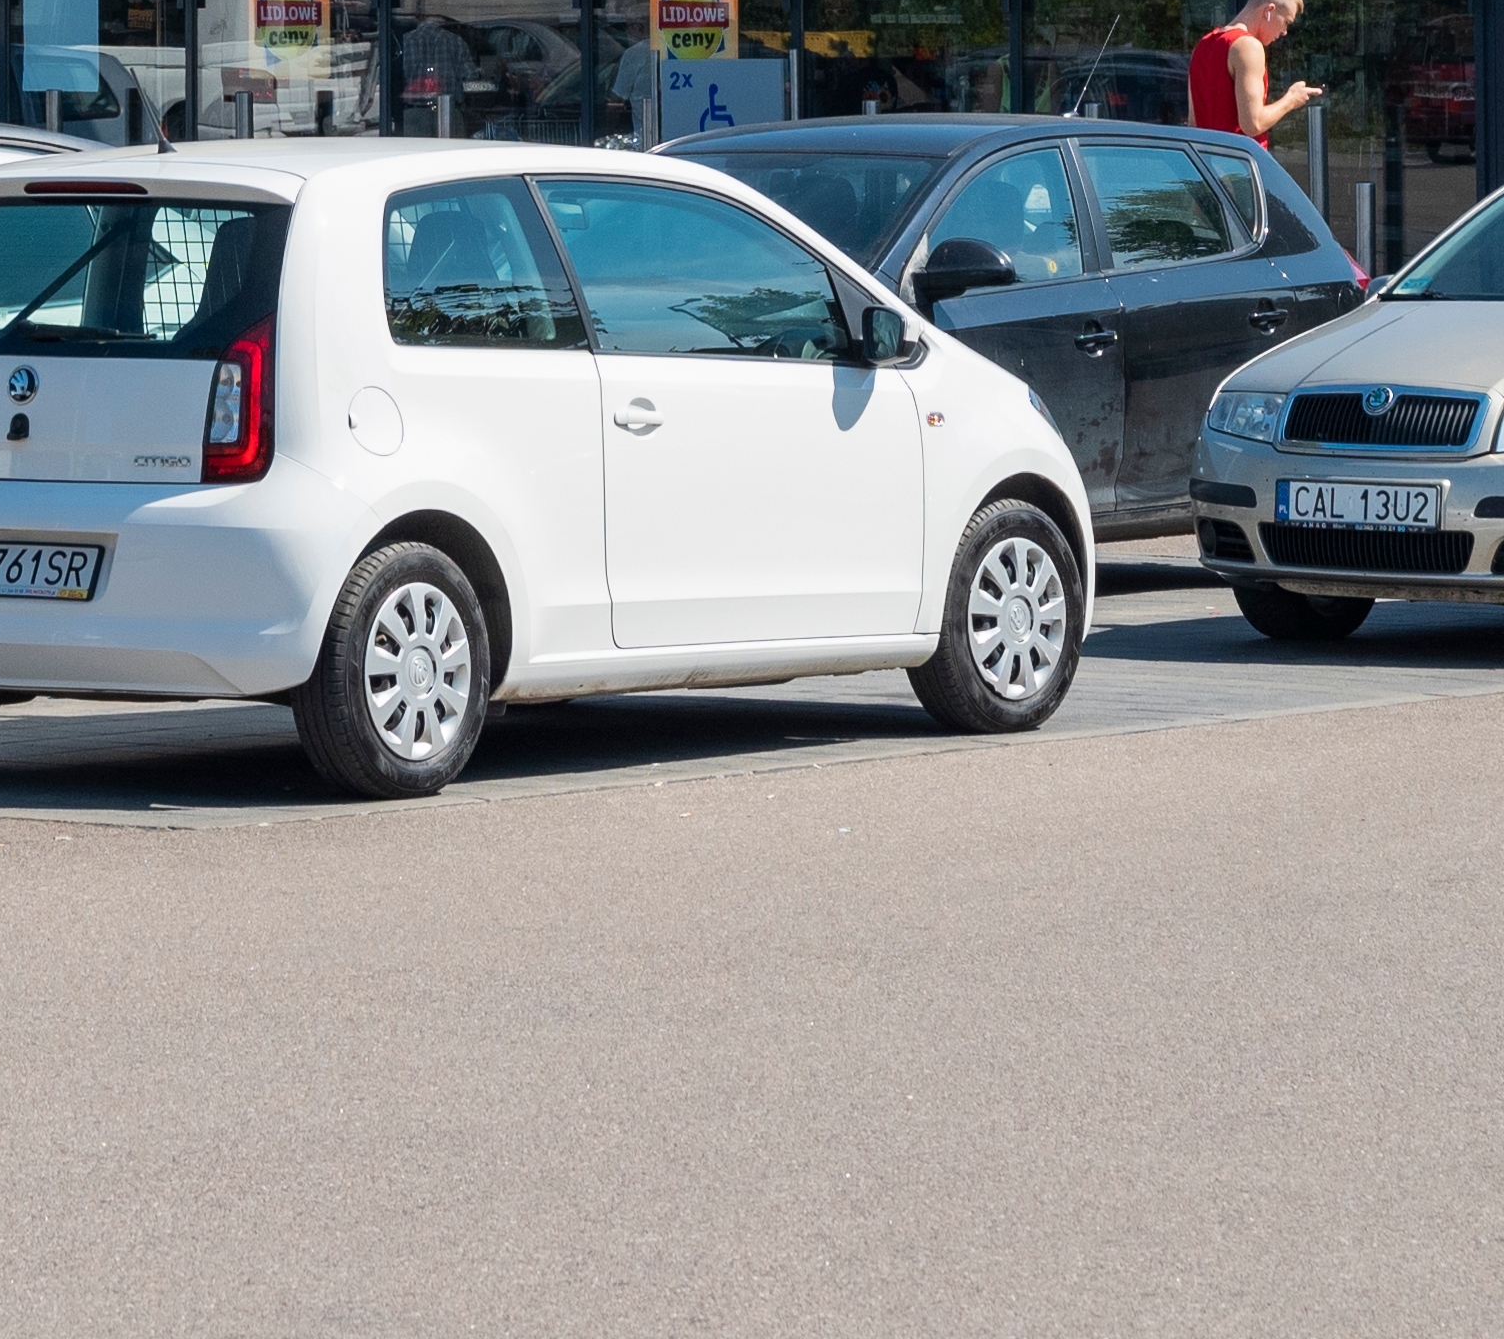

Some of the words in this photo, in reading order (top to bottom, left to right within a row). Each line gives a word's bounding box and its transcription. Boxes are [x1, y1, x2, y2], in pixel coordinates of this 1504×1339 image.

[260, 5, 319, 21] LIDLOWE
[662, 5, 725, 23] LIDLOWE
[269, 30, 309, 46] ceny
[672, 32, 715, 50] ceny
[669, 71, 693, 91] 2x
[134, 455, 191, 467] CITIGO
[1278, 504, 1288, 514] PL
[1295, 486, 1344, 519] CAL
[1360, 488, 1429, 523] 13U2
